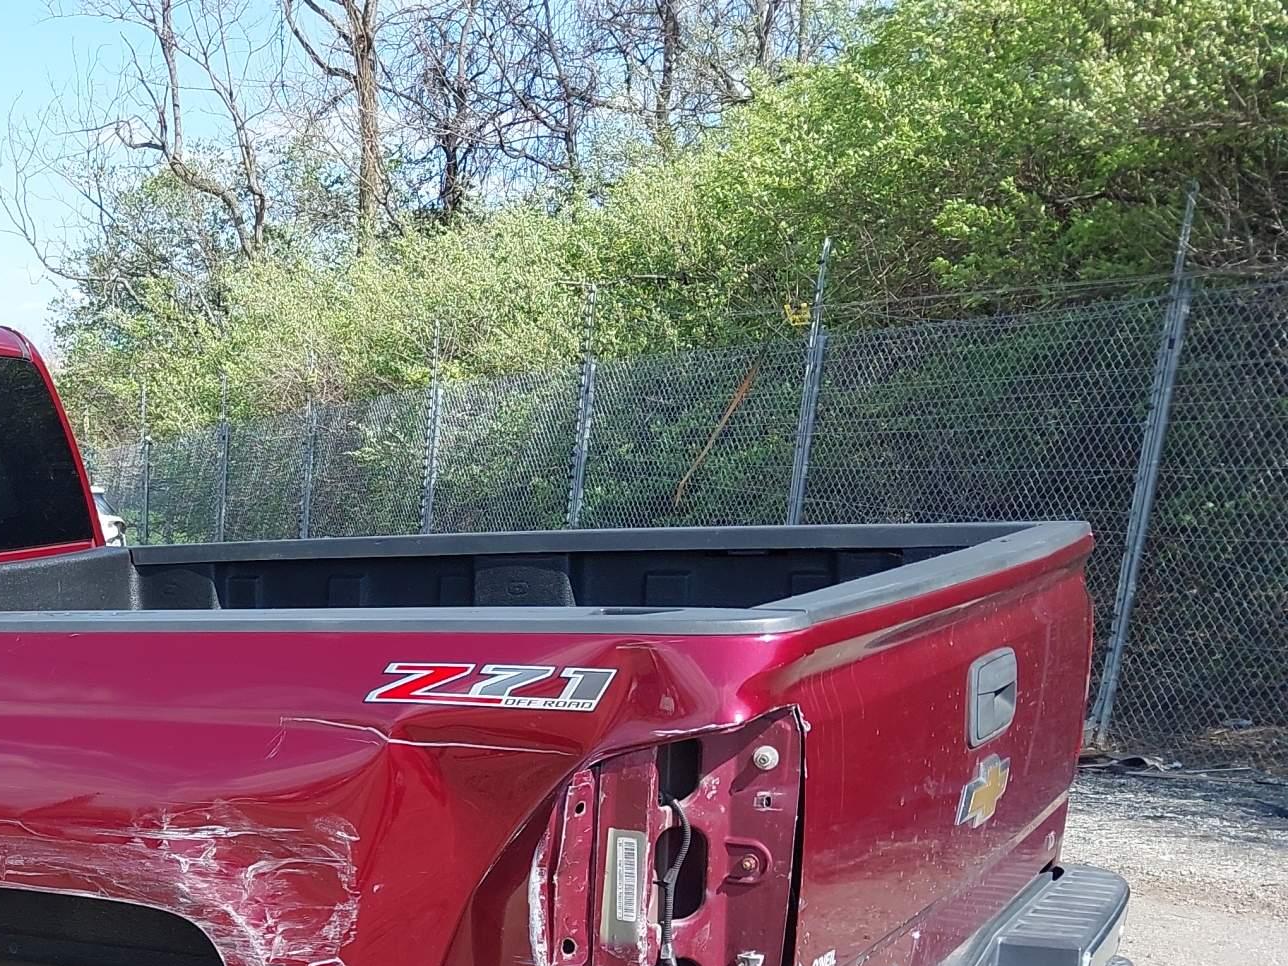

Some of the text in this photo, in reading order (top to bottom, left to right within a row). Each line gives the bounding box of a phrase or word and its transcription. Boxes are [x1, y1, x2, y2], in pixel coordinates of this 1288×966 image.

[363, 662, 618, 709] Z71
[504, 697, 594, 709] OFF ROAD
